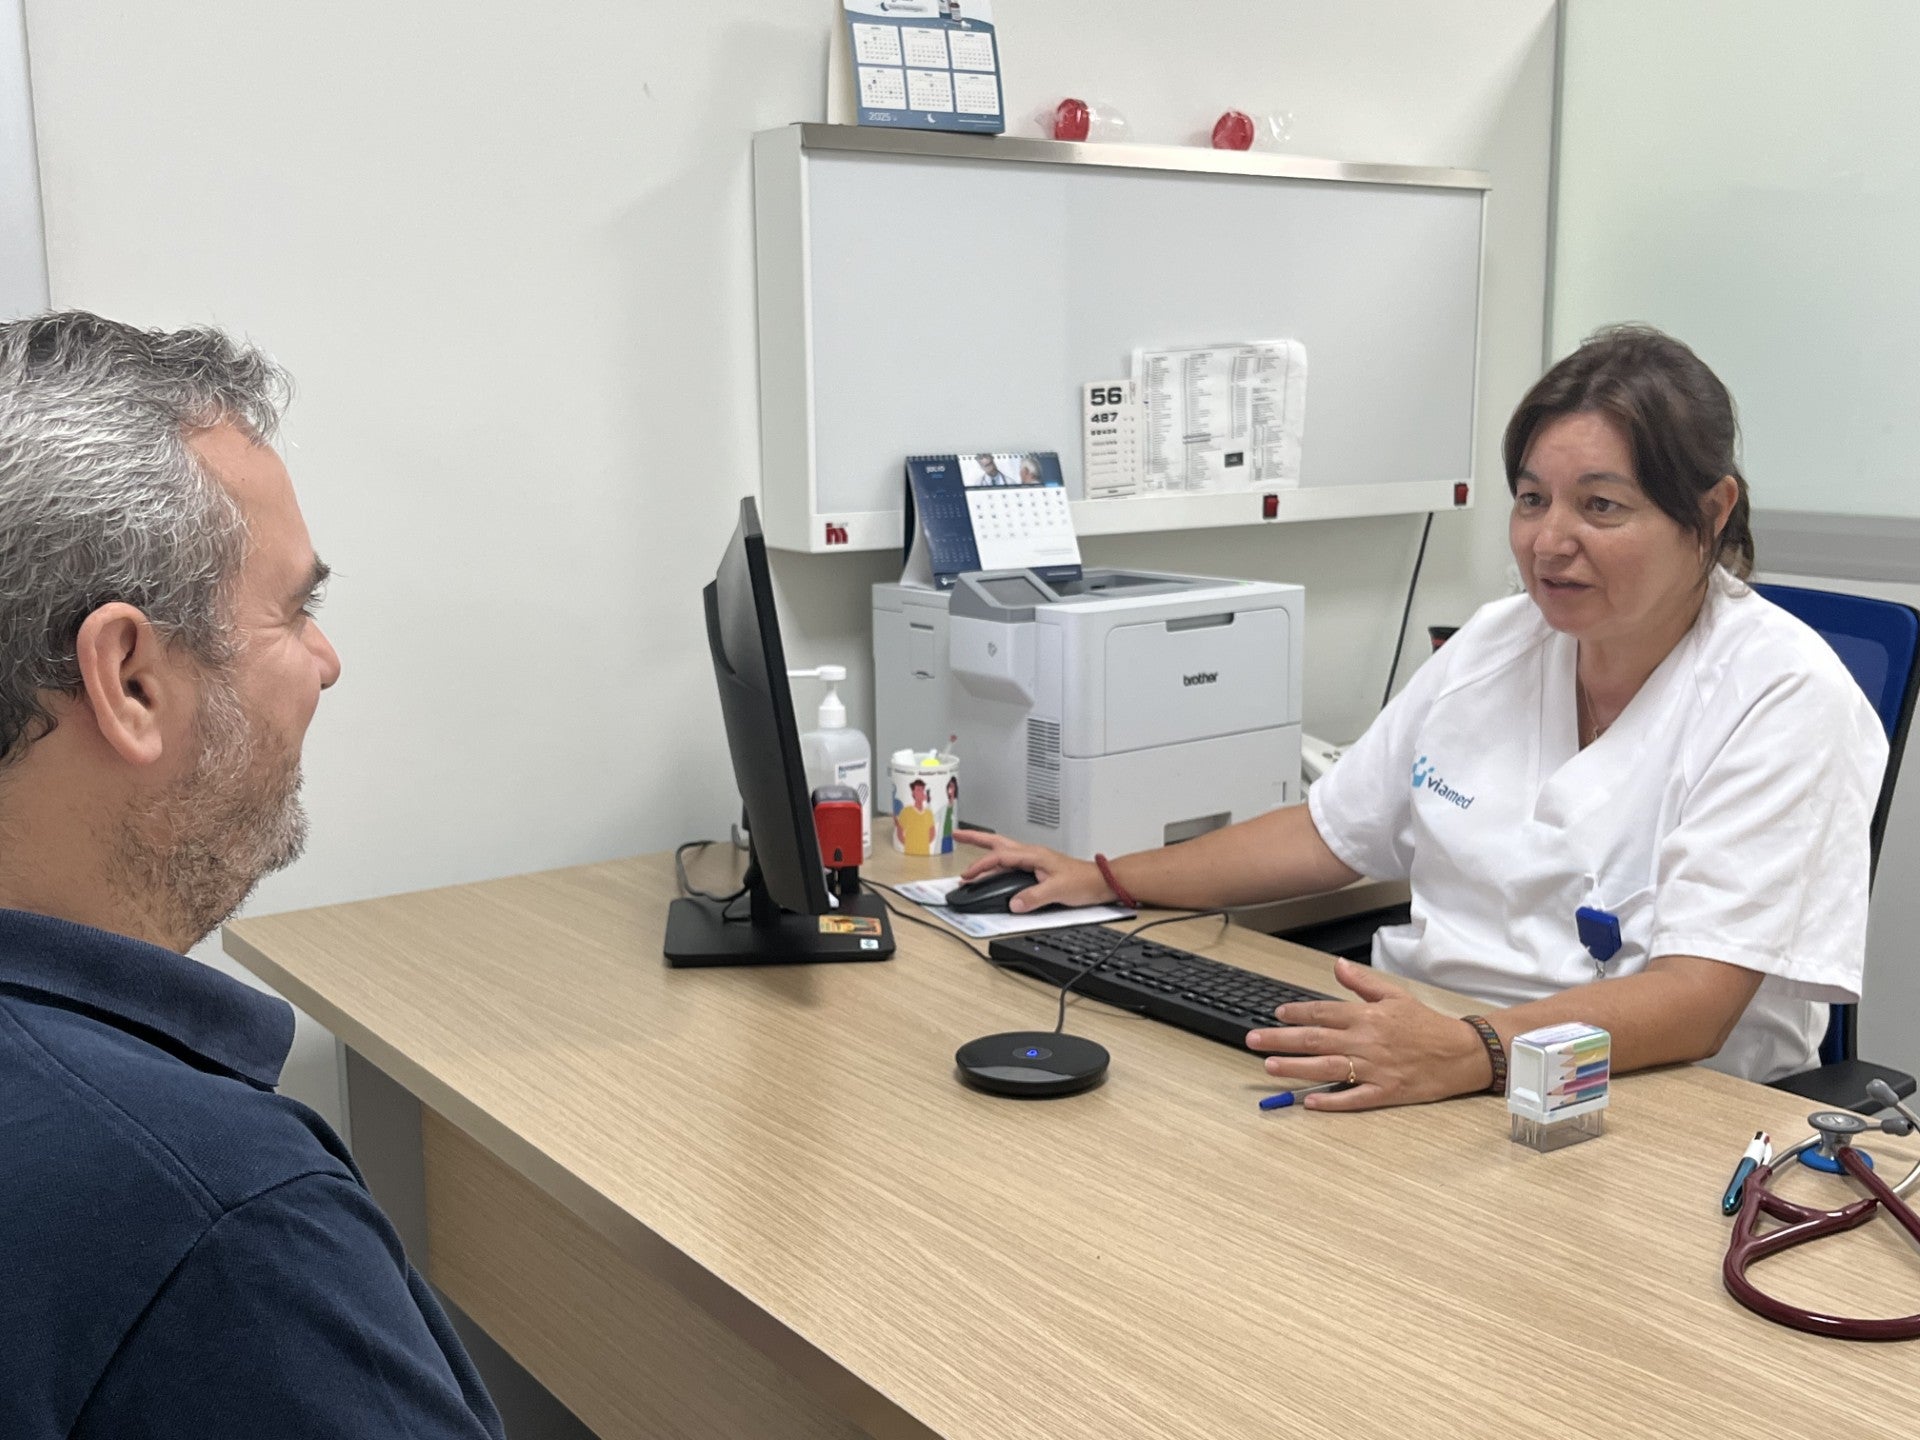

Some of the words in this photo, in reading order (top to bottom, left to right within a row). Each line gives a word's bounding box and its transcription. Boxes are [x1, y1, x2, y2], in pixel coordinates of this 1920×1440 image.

[1090, 386, 1122, 406] 56
[1090, 411, 1119, 424] 487
[1183, 672, 1218, 686] brother
[1427, 776, 1475, 809] viamed
